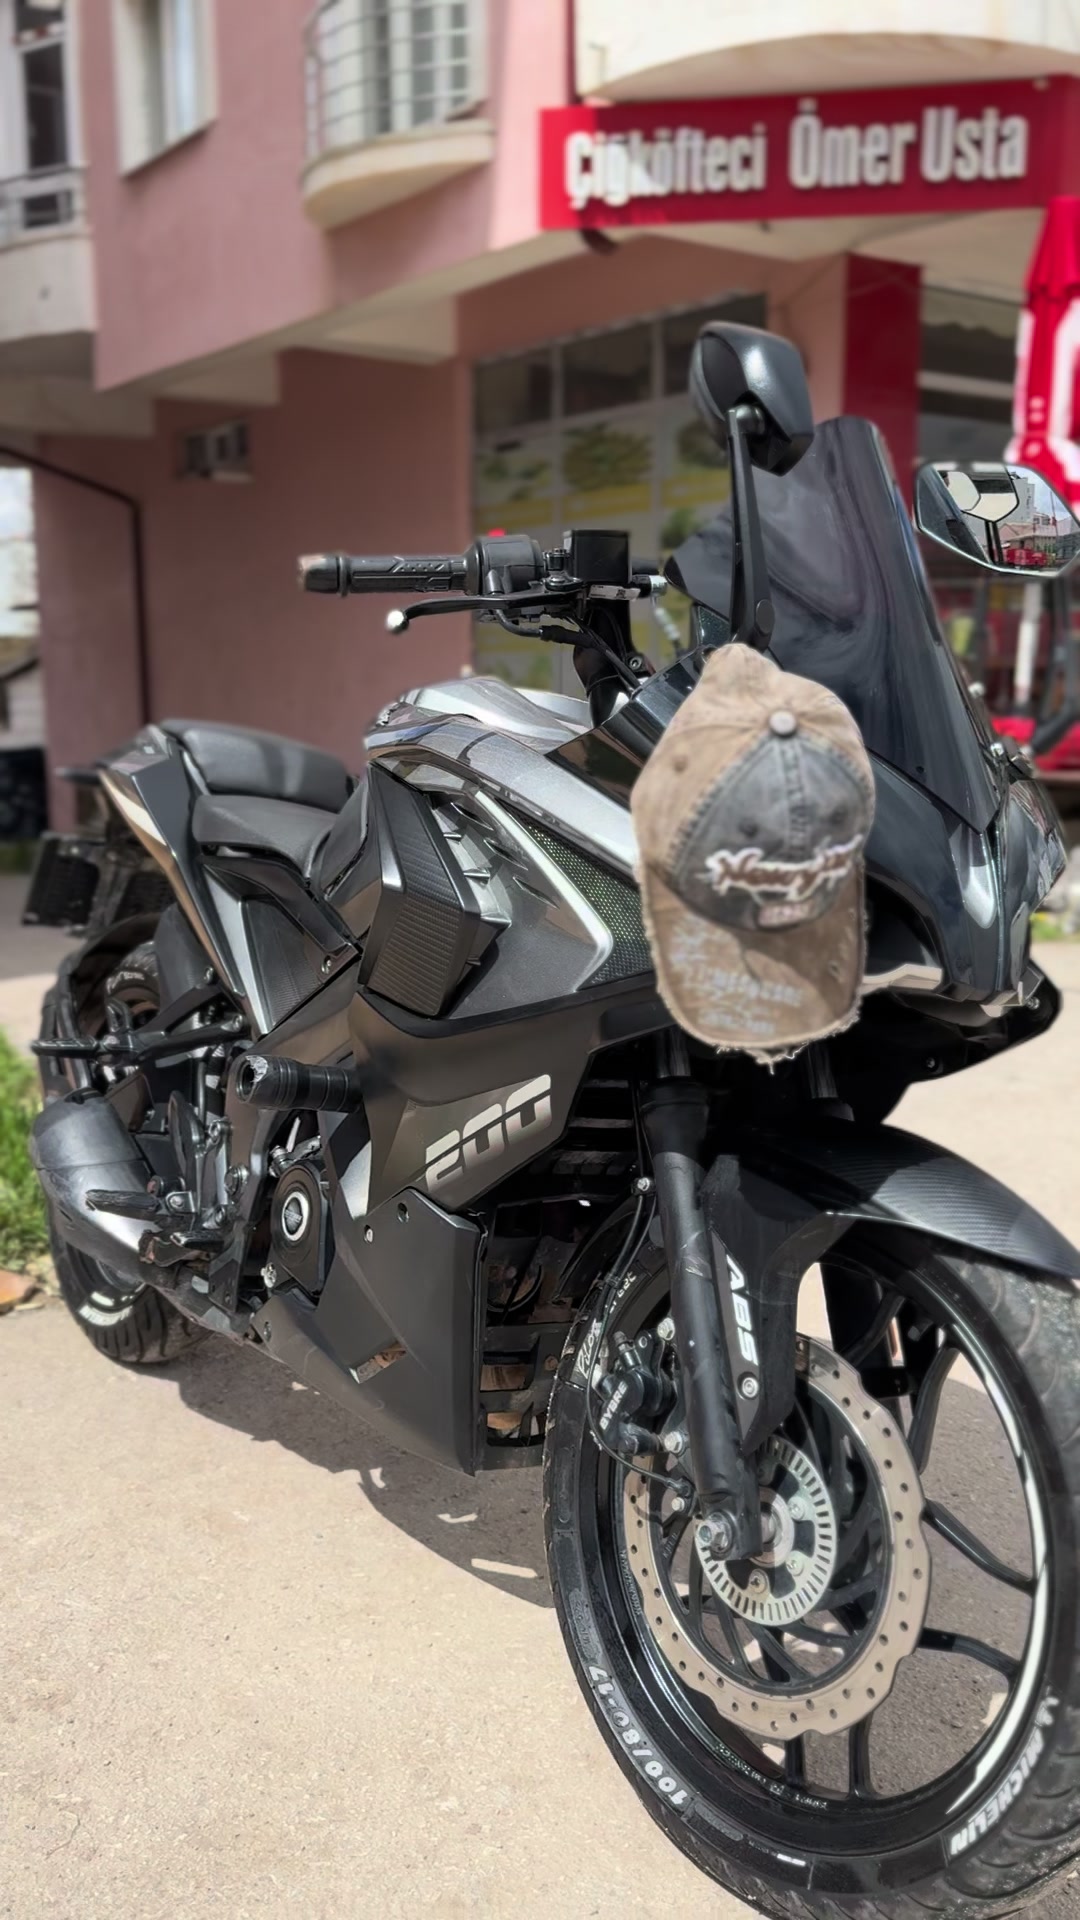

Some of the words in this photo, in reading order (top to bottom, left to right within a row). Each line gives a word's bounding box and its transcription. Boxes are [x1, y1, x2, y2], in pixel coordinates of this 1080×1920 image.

[788, 98, 915, 188] Ömer
[921, 106, 1029, 184] Usta
[425, 1074, 552, 1194] 200
[726, 1253, 759, 1366] ABS
[599, 1380, 628, 1430] BYBRE
[588, 1665, 689, 1805] 100/80-17
[951, 1727, 1045, 1856] MICHELIN
